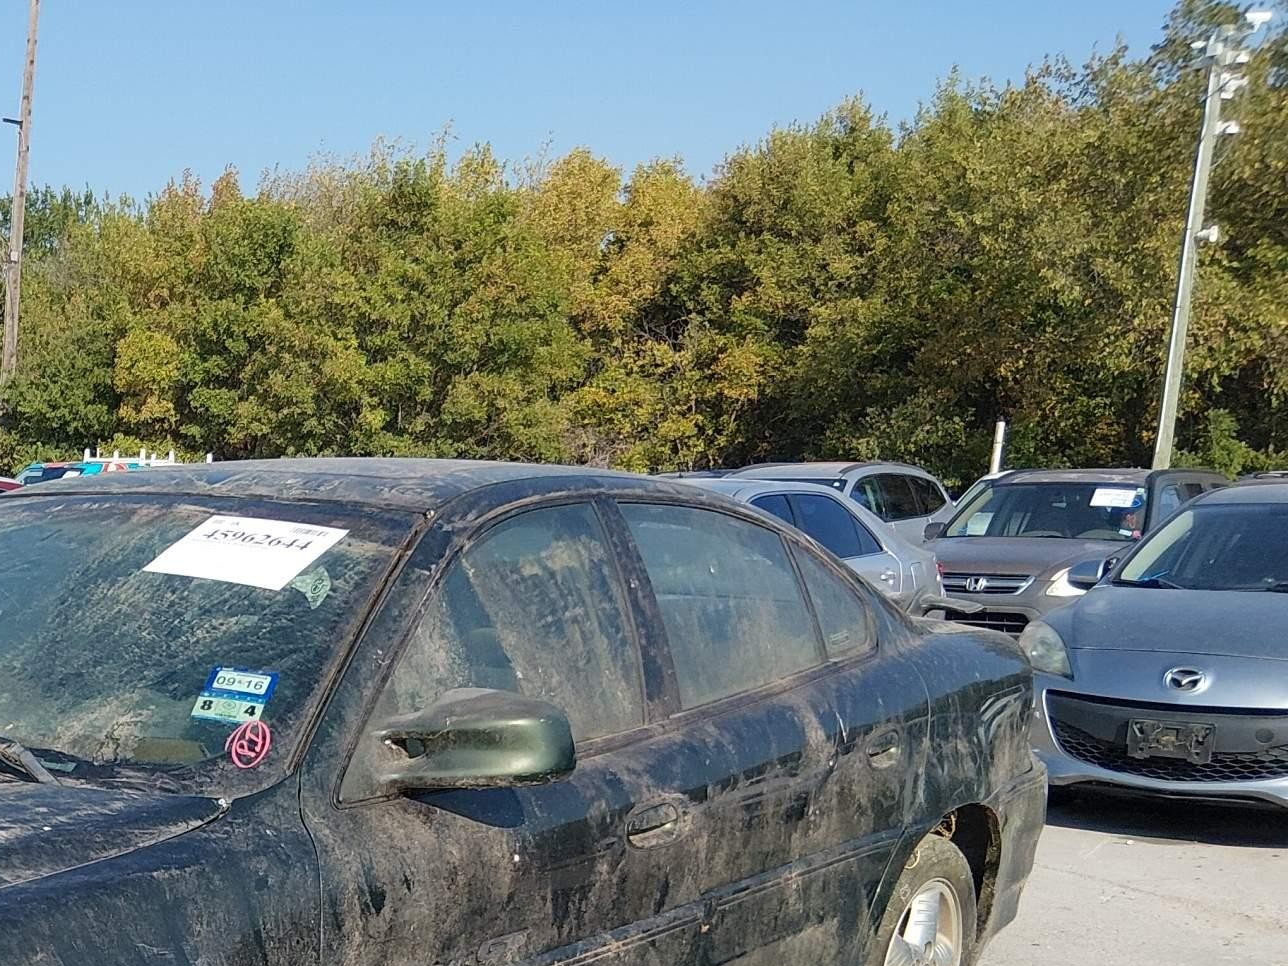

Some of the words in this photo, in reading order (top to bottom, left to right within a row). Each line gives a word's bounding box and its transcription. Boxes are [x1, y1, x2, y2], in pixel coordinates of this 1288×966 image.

[202, 528, 314, 552] 45962644
[216, 675, 237, 687] 09
[245, 679, 265, 691] 16
[199, 699, 214, 711] 8
[243, 704, 257, 718] 4
